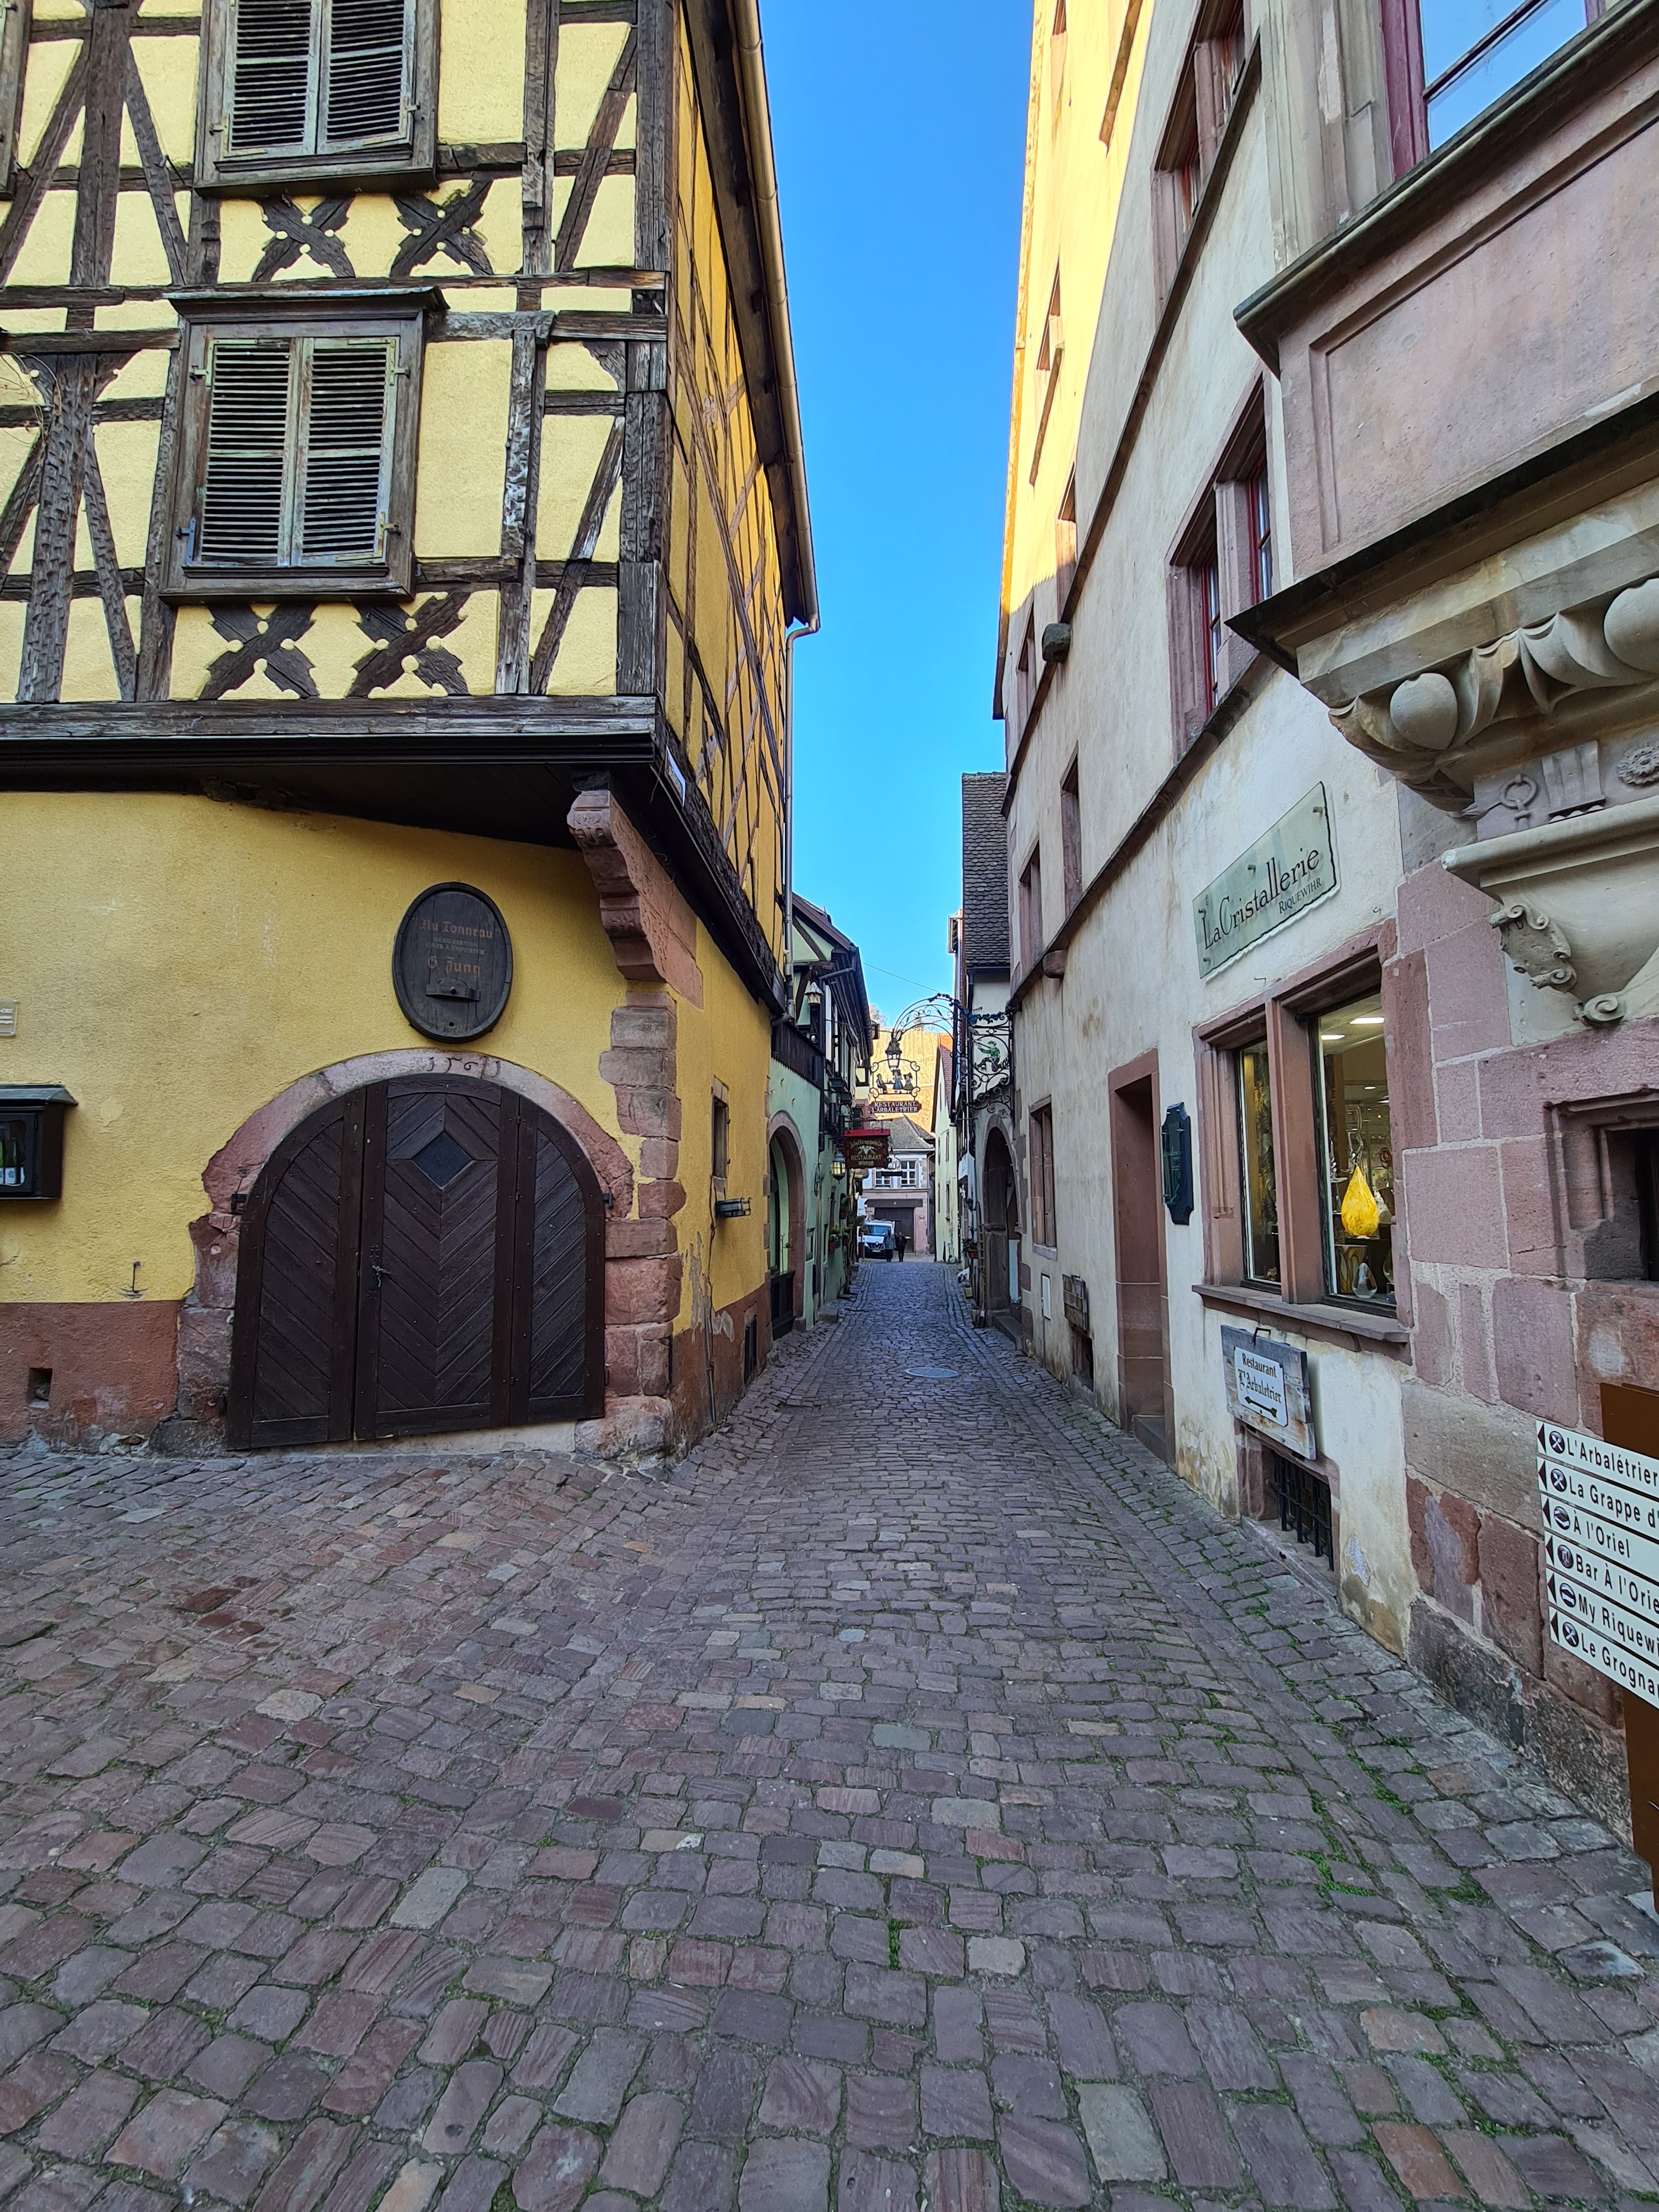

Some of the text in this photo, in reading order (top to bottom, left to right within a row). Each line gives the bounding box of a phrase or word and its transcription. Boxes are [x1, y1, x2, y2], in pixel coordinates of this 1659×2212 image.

[1278, 877, 1322, 914] RIQUEWIHR
[442, 921, 493, 938] Tonneau
[1241, 1353, 1277, 1379] Restaurant
[1567, 1437, 1658, 1487] L'Arbalétrier
[1568, 1475, 1584, 1499] La
[1589, 1484, 1641, 1521] Grappe
[1573, 1510, 1630, 1558] À l'Oriel
[1575, 1553, 1598, 1582] Bar
[1604, 1563, 1613, 1590] À
[1578, 1593, 1595, 1624] My
[1581, 1632, 1597, 1658] Le
